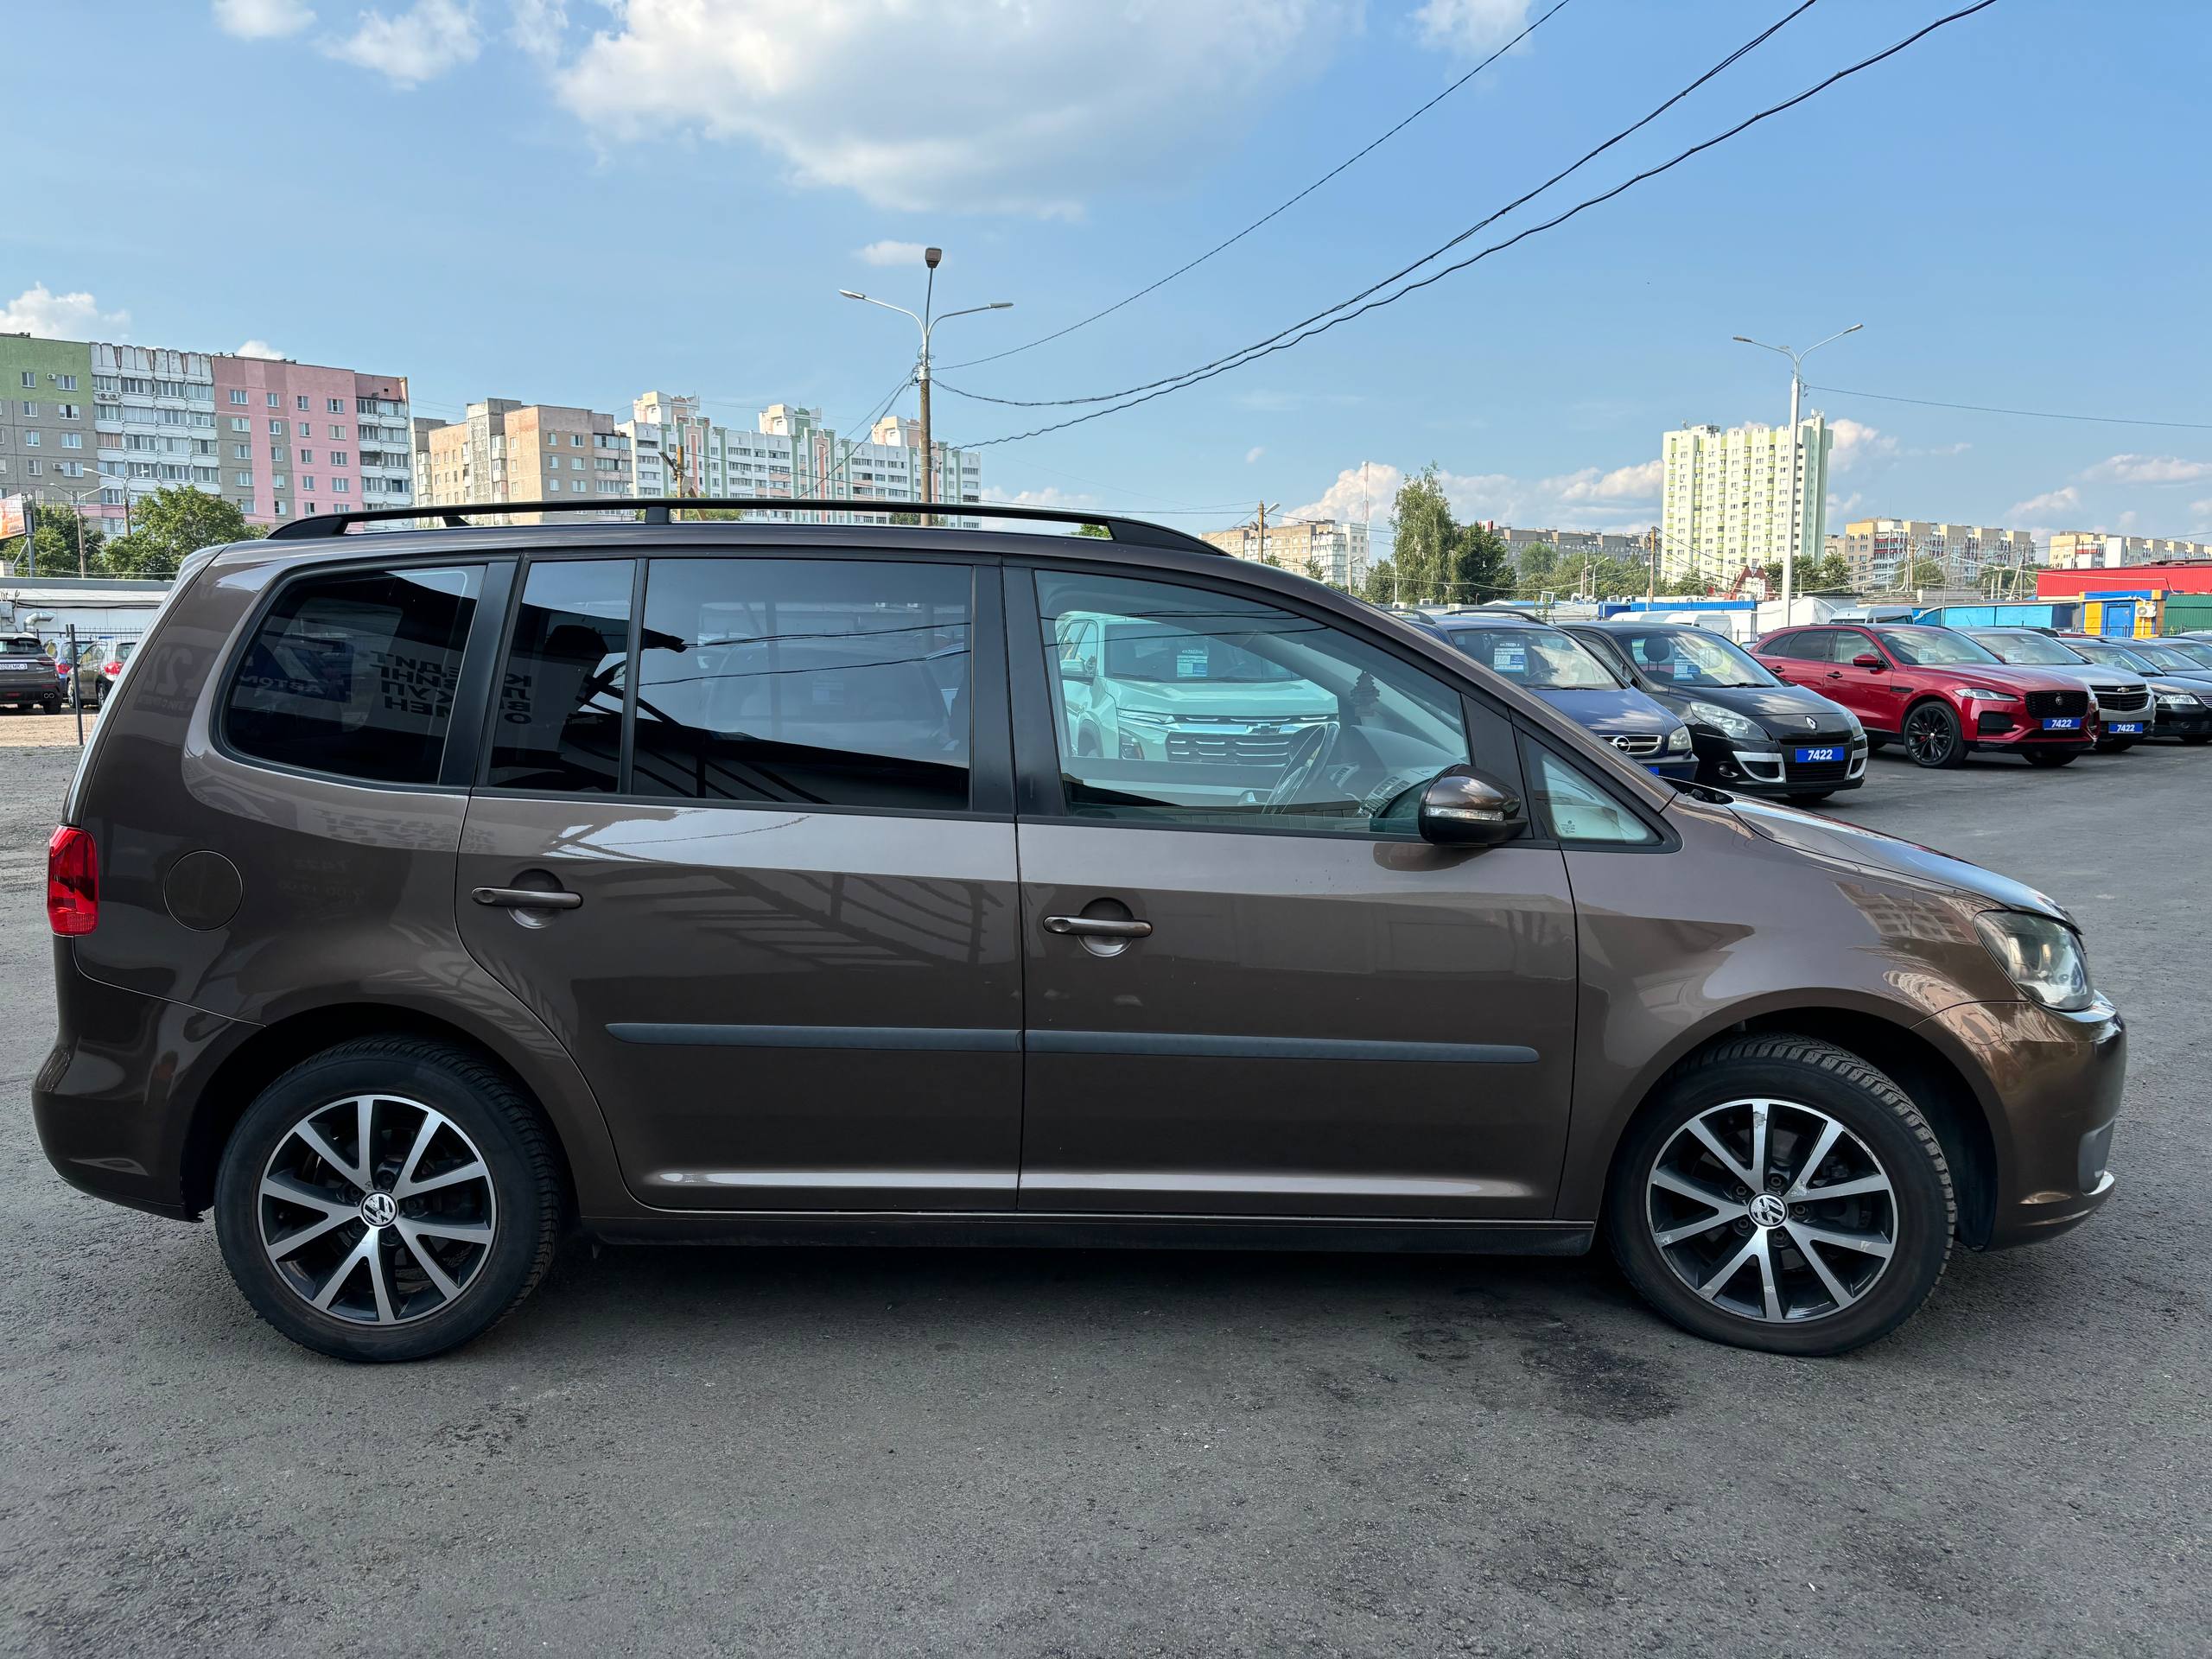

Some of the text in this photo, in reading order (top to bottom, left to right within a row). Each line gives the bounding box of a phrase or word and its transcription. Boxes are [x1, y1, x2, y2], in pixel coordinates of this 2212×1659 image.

[2051, 719, 2072, 728] 7422
[2116, 724, 2135, 733] 7422
[1808, 749, 1833, 760] 7422
